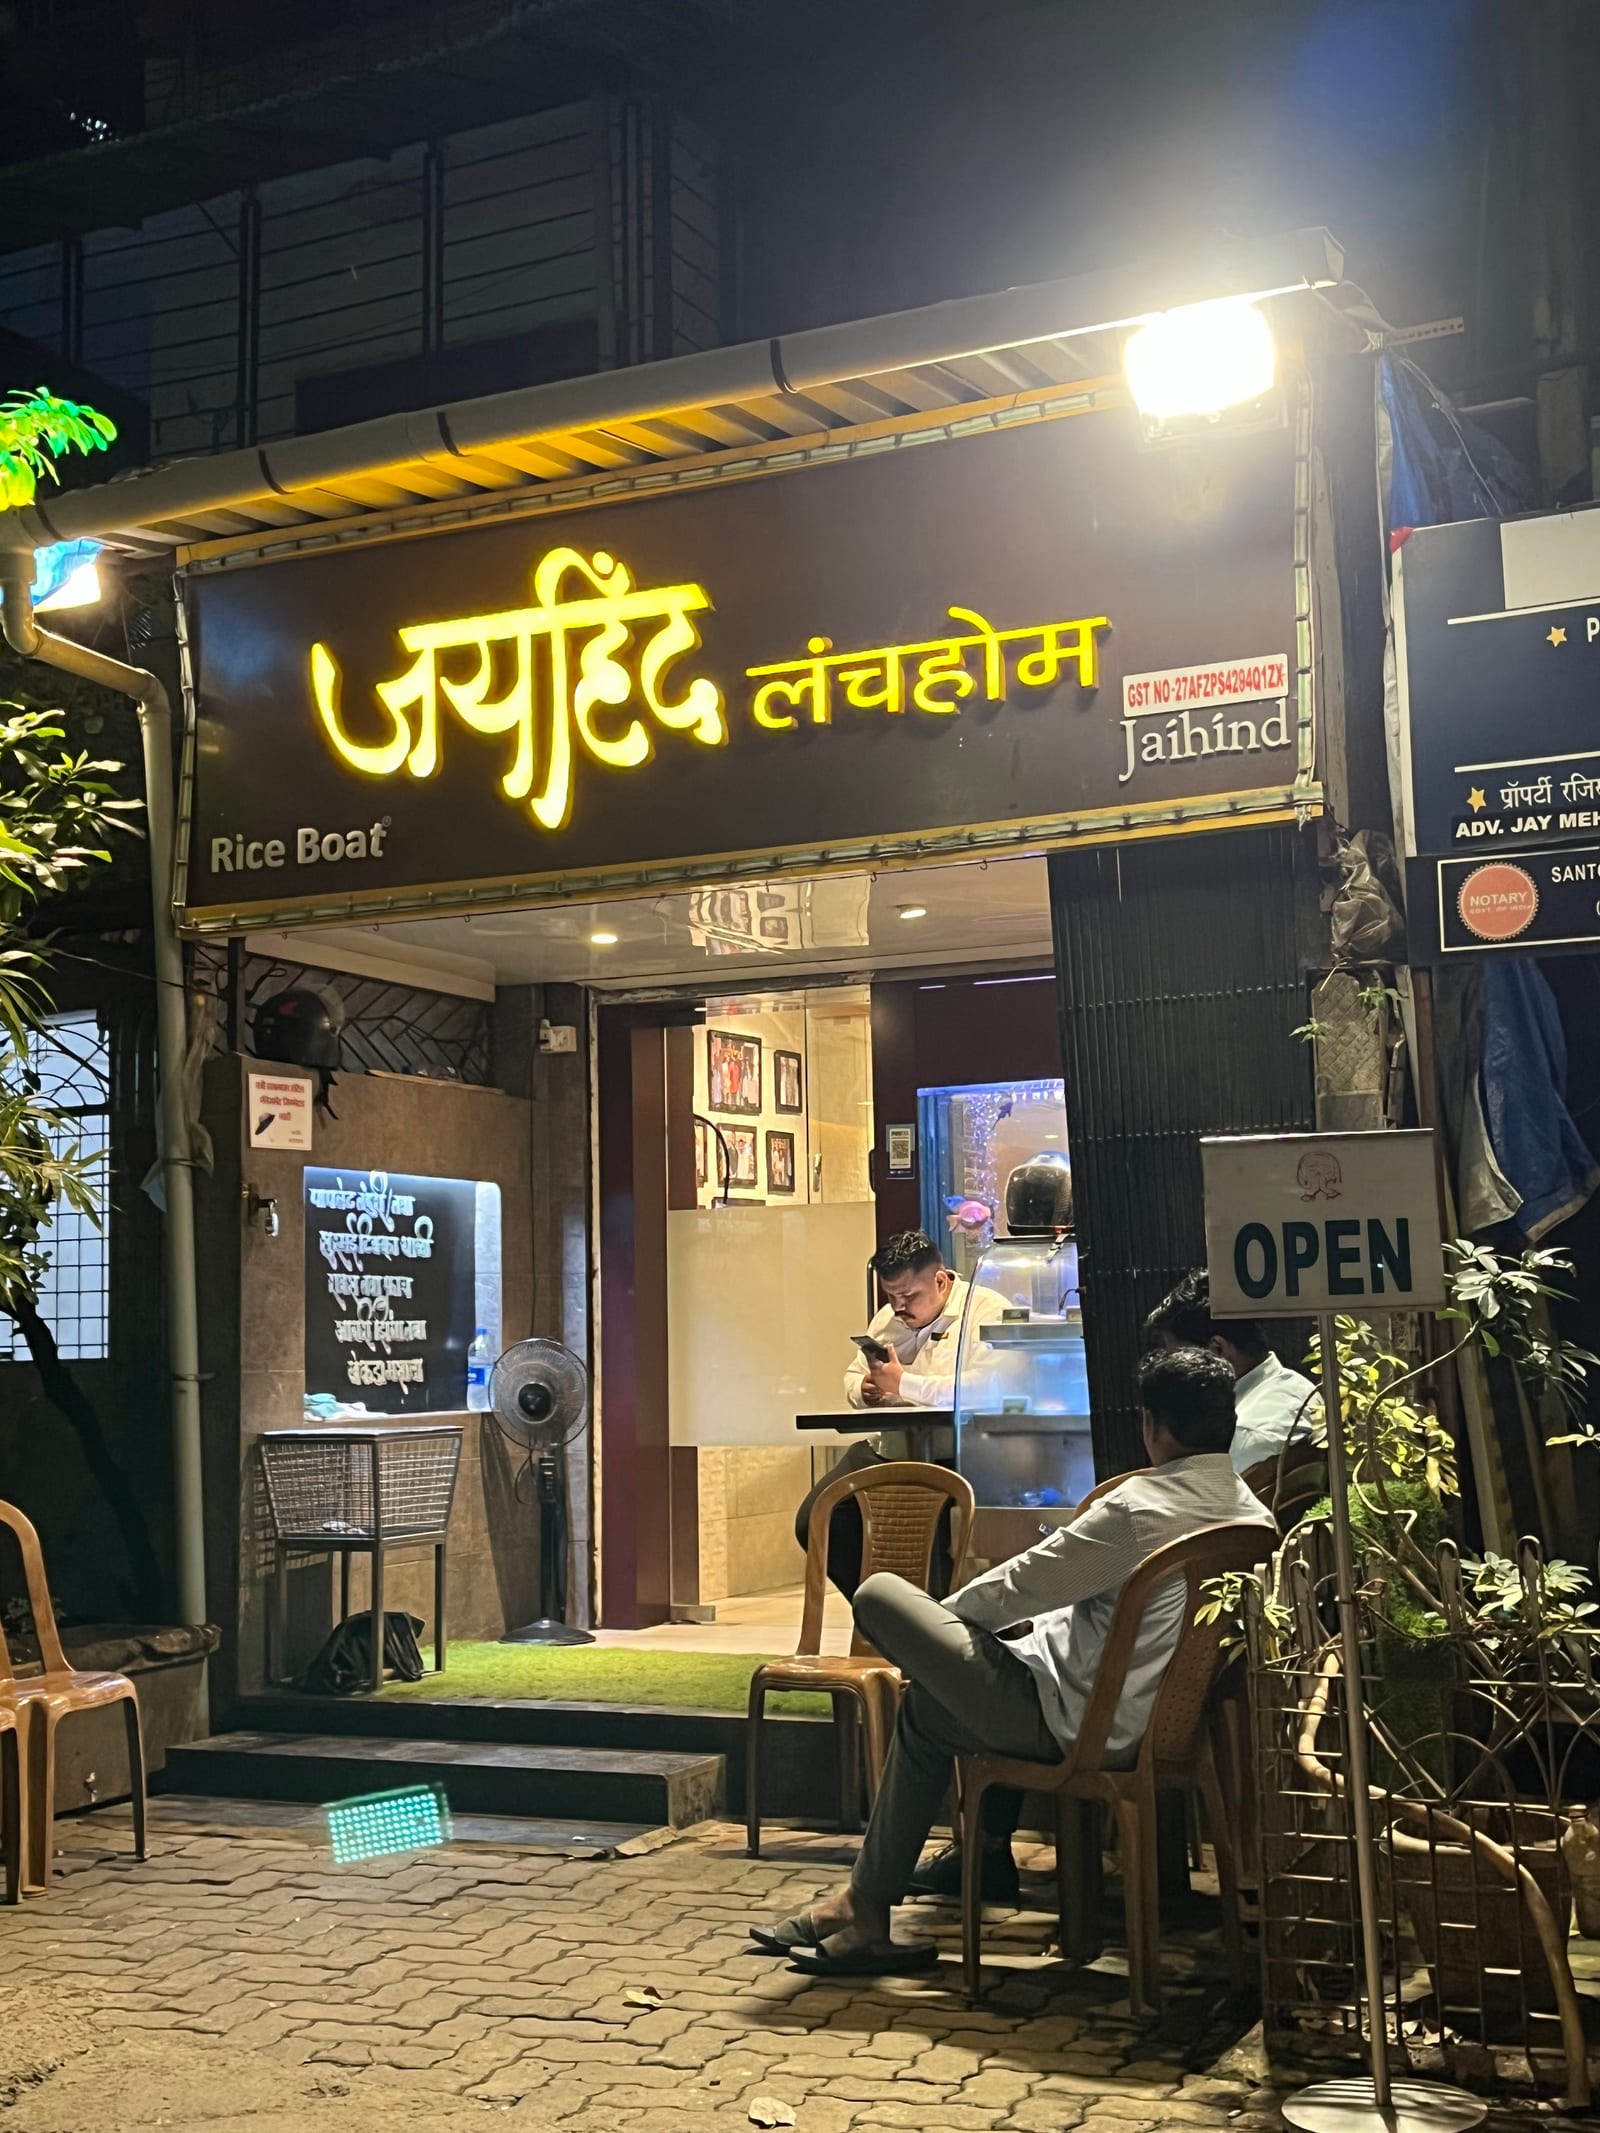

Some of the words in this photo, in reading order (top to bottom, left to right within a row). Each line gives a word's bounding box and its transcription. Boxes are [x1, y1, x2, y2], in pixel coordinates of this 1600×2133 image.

[745, 606, 1113, 730] लंचहोम
[1127, 682, 1150, 708] GST
[1118, 697, 1292, 782] Jaihind
[1455, 819, 1504, 838] ADV.
[1510, 815, 1553, 833] JAY
[211, 833, 286, 873] Rice
[1470, 891, 1528, 907] NOTARY
[1234, 1218, 1413, 1299] OPEN
